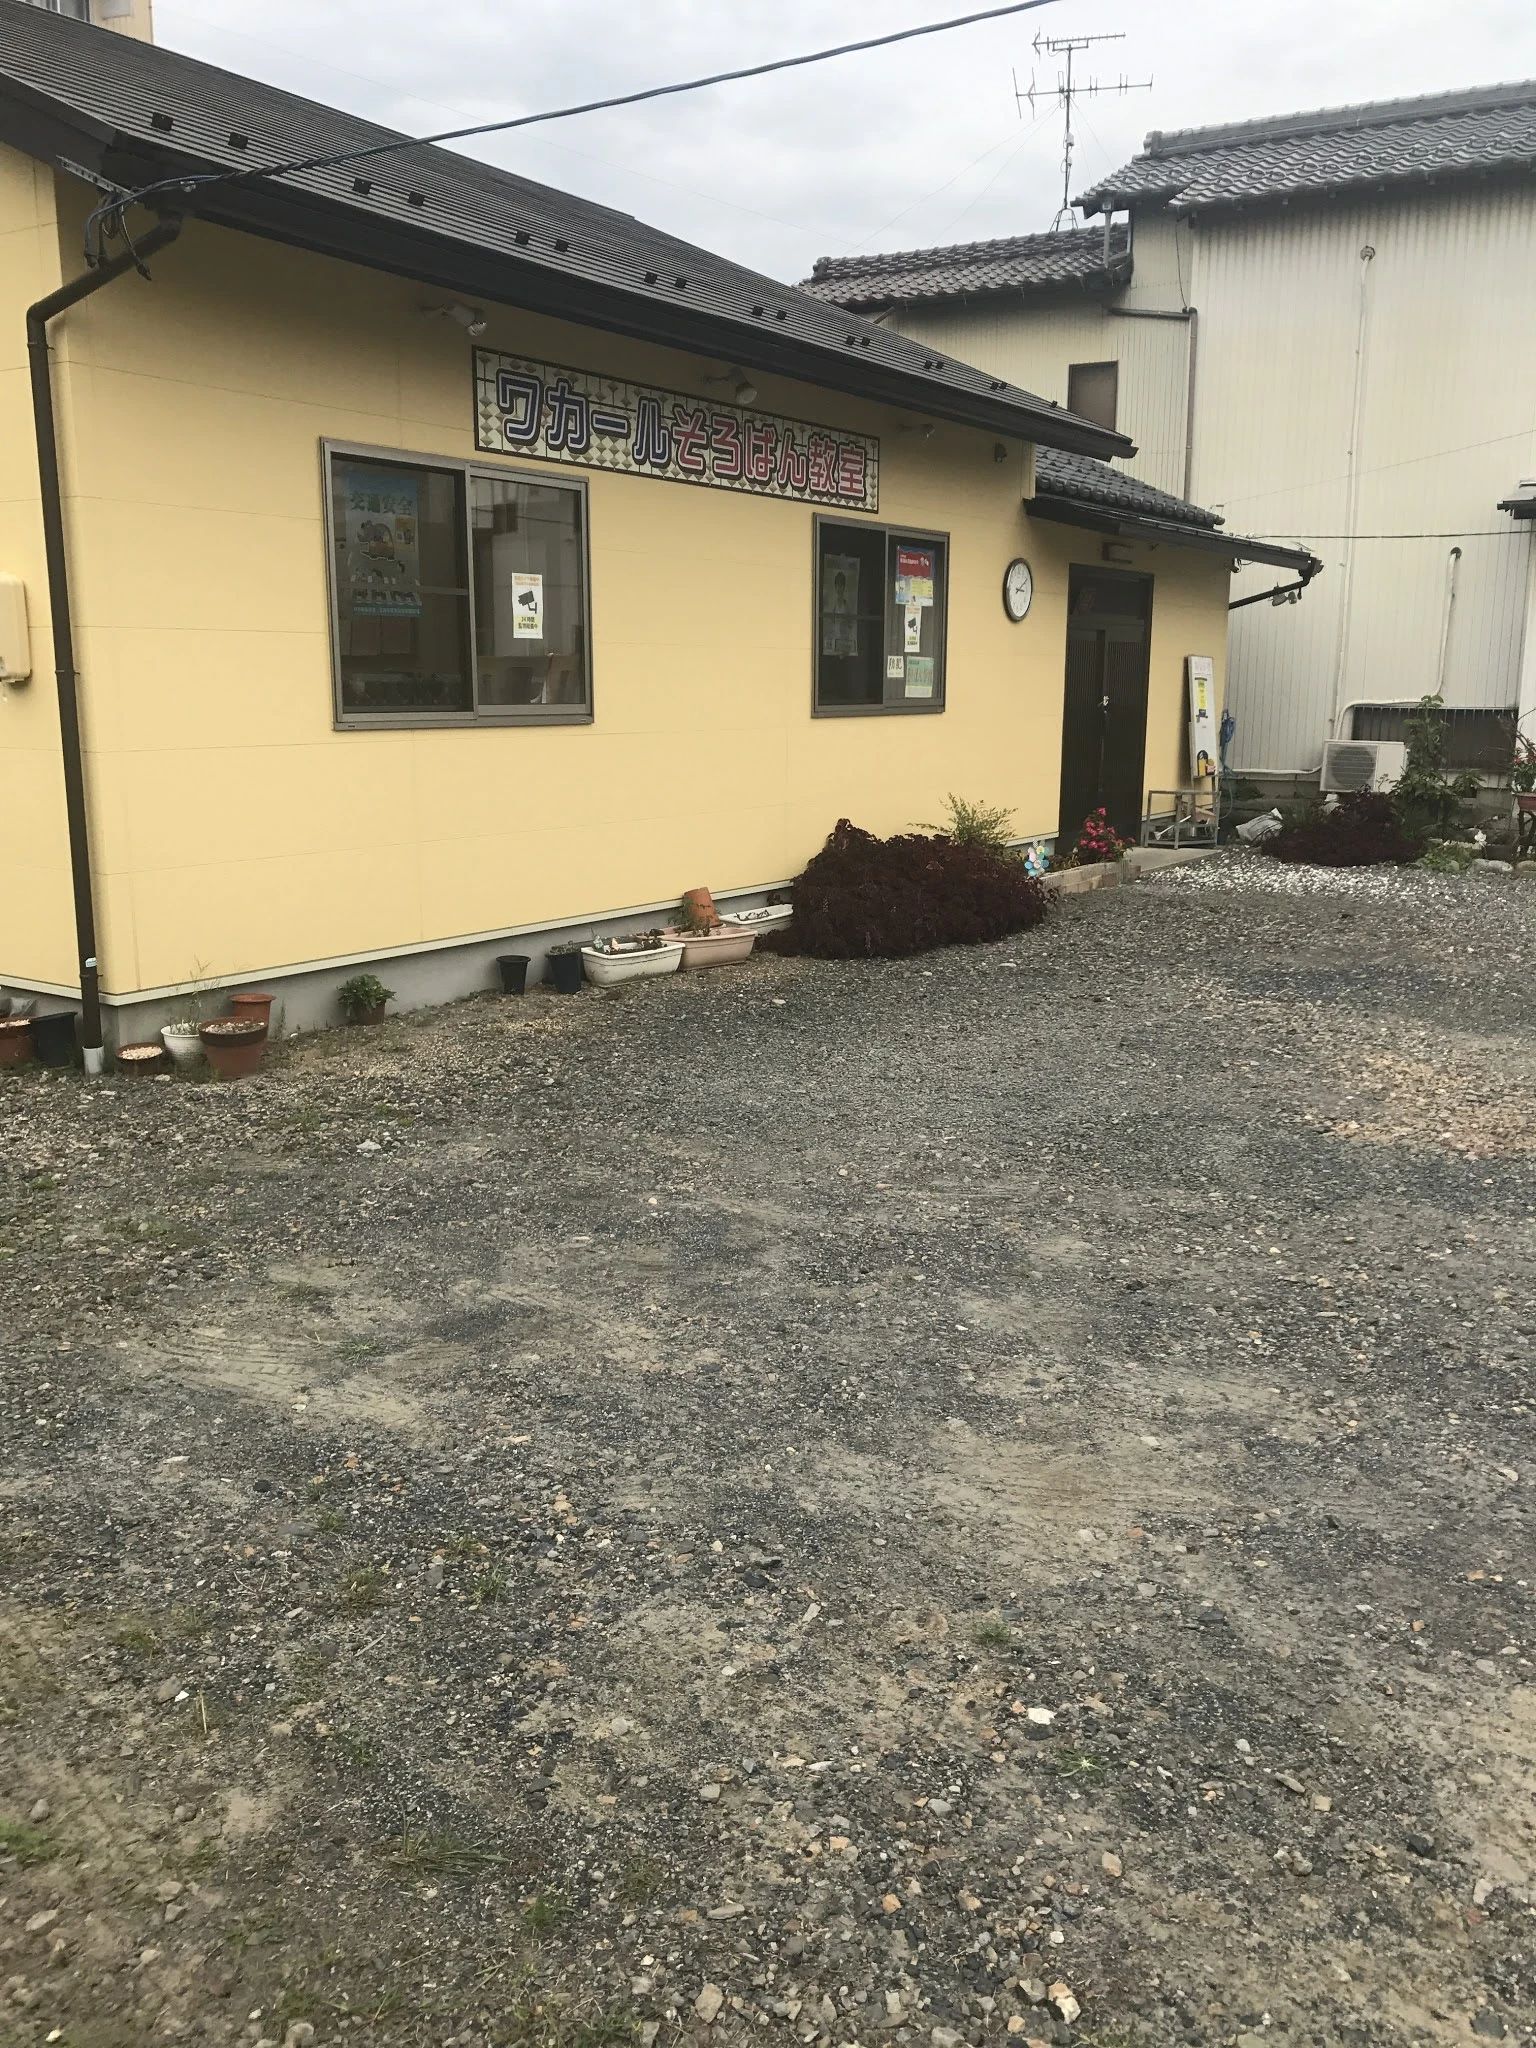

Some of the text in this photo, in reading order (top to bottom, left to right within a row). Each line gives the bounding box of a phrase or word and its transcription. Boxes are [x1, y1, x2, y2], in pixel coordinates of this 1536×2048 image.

[496, 368, 867, 501] ワカールそろばん教室
